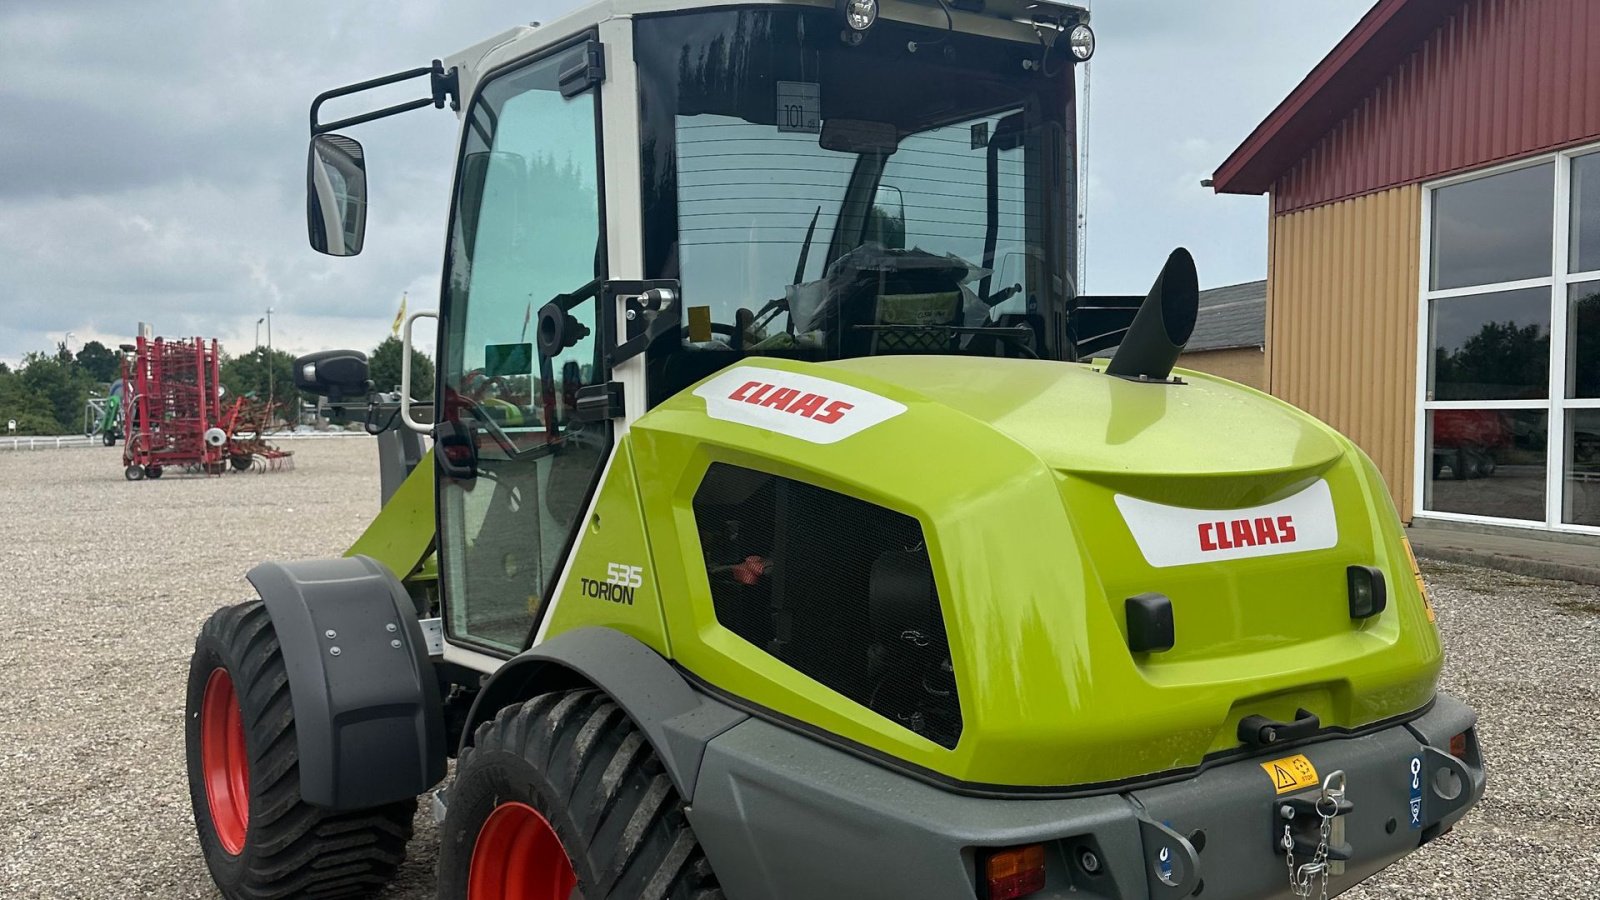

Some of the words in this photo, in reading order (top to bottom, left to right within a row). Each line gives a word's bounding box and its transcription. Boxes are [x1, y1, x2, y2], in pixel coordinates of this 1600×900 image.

[784, 104, 803, 128] 101
[728, 381, 855, 425] CLAAS
[1198, 515, 1296, 551] CLAAS
[606, 562, 643, 588] 535
[581, 577, 635, 605] TORION
